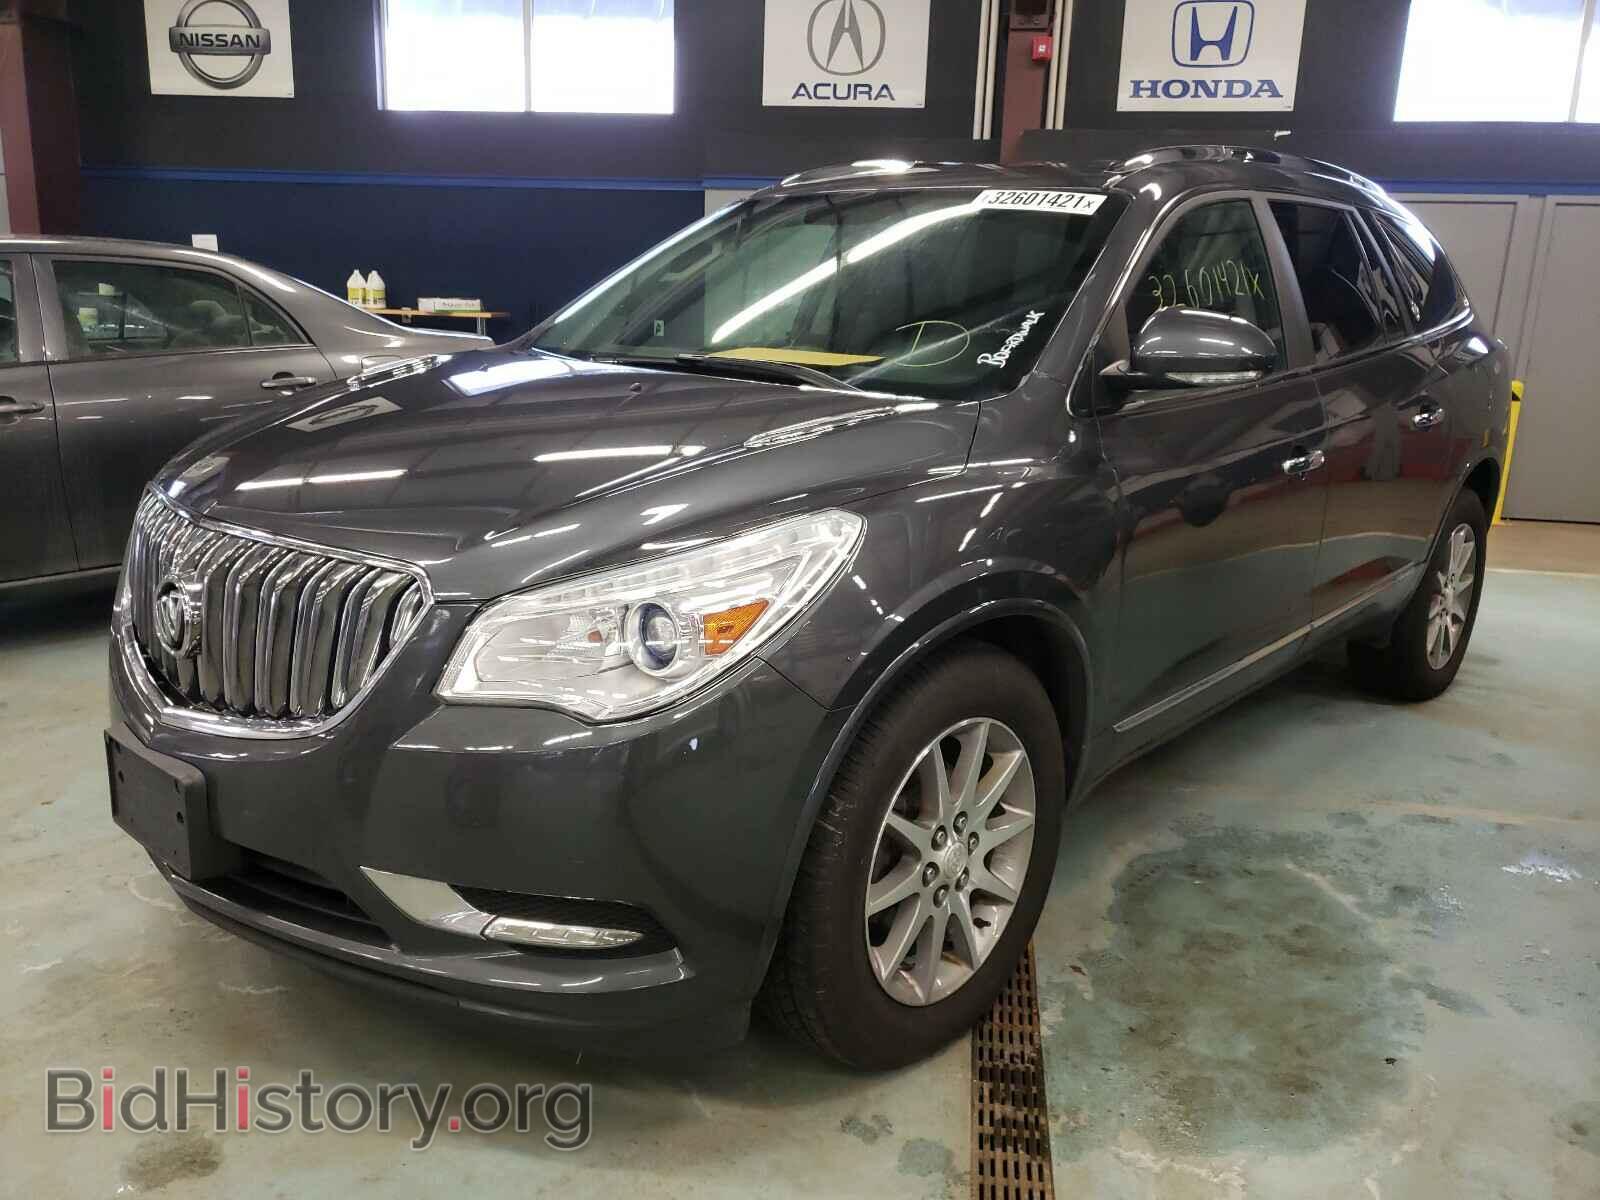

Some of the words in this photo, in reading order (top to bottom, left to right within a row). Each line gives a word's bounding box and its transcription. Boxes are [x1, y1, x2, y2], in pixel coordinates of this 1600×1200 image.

[179, 32, 260, 49] NISSAN
[791, 82, 896, 101] ACURA
[1129, 79, 1284, 99] HONDA
